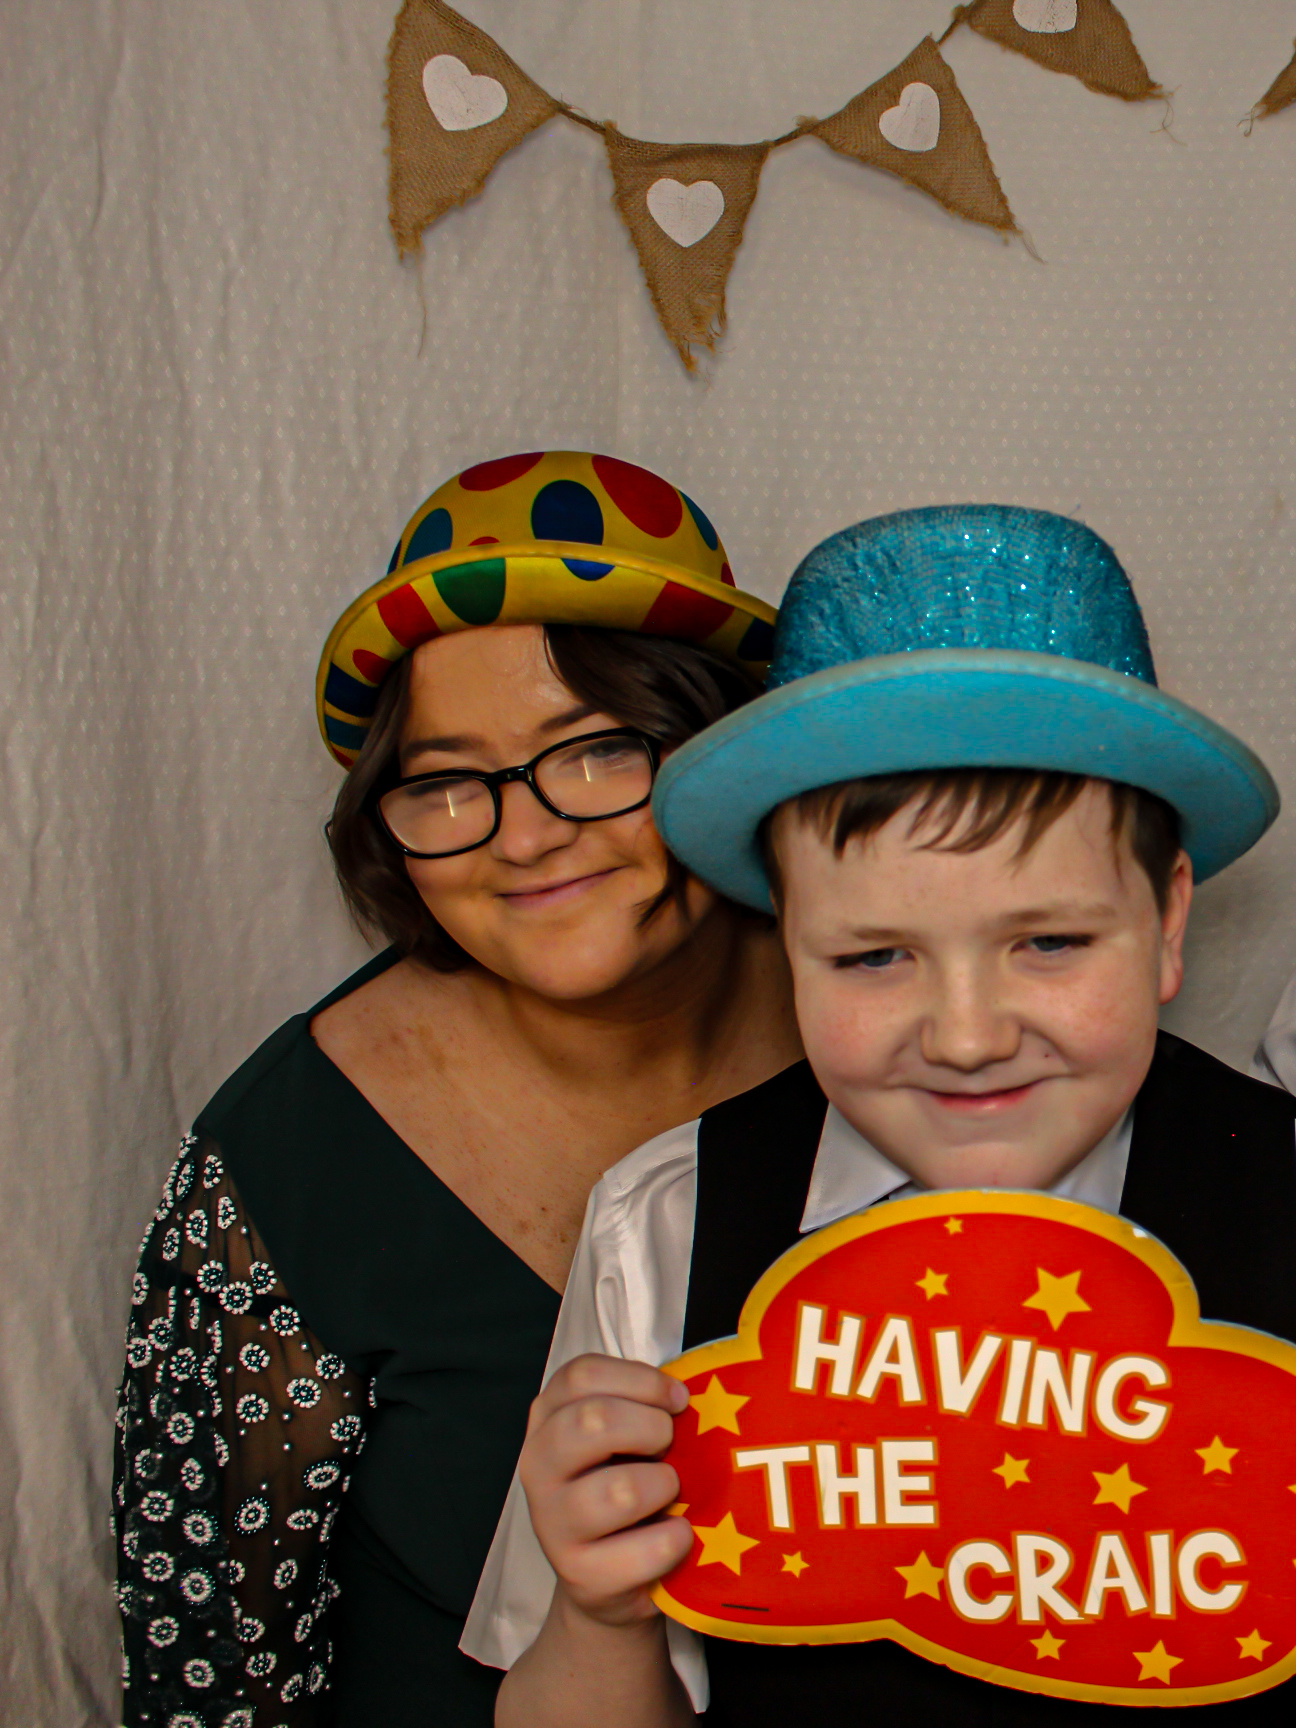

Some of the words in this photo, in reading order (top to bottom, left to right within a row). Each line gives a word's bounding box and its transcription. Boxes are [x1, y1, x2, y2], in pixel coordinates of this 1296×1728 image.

[793, 1304, 1170, 1441] HAVING
[735, 1440, 936, 1529] THE
[947, 1531, 1246, 1623] CRAIC
